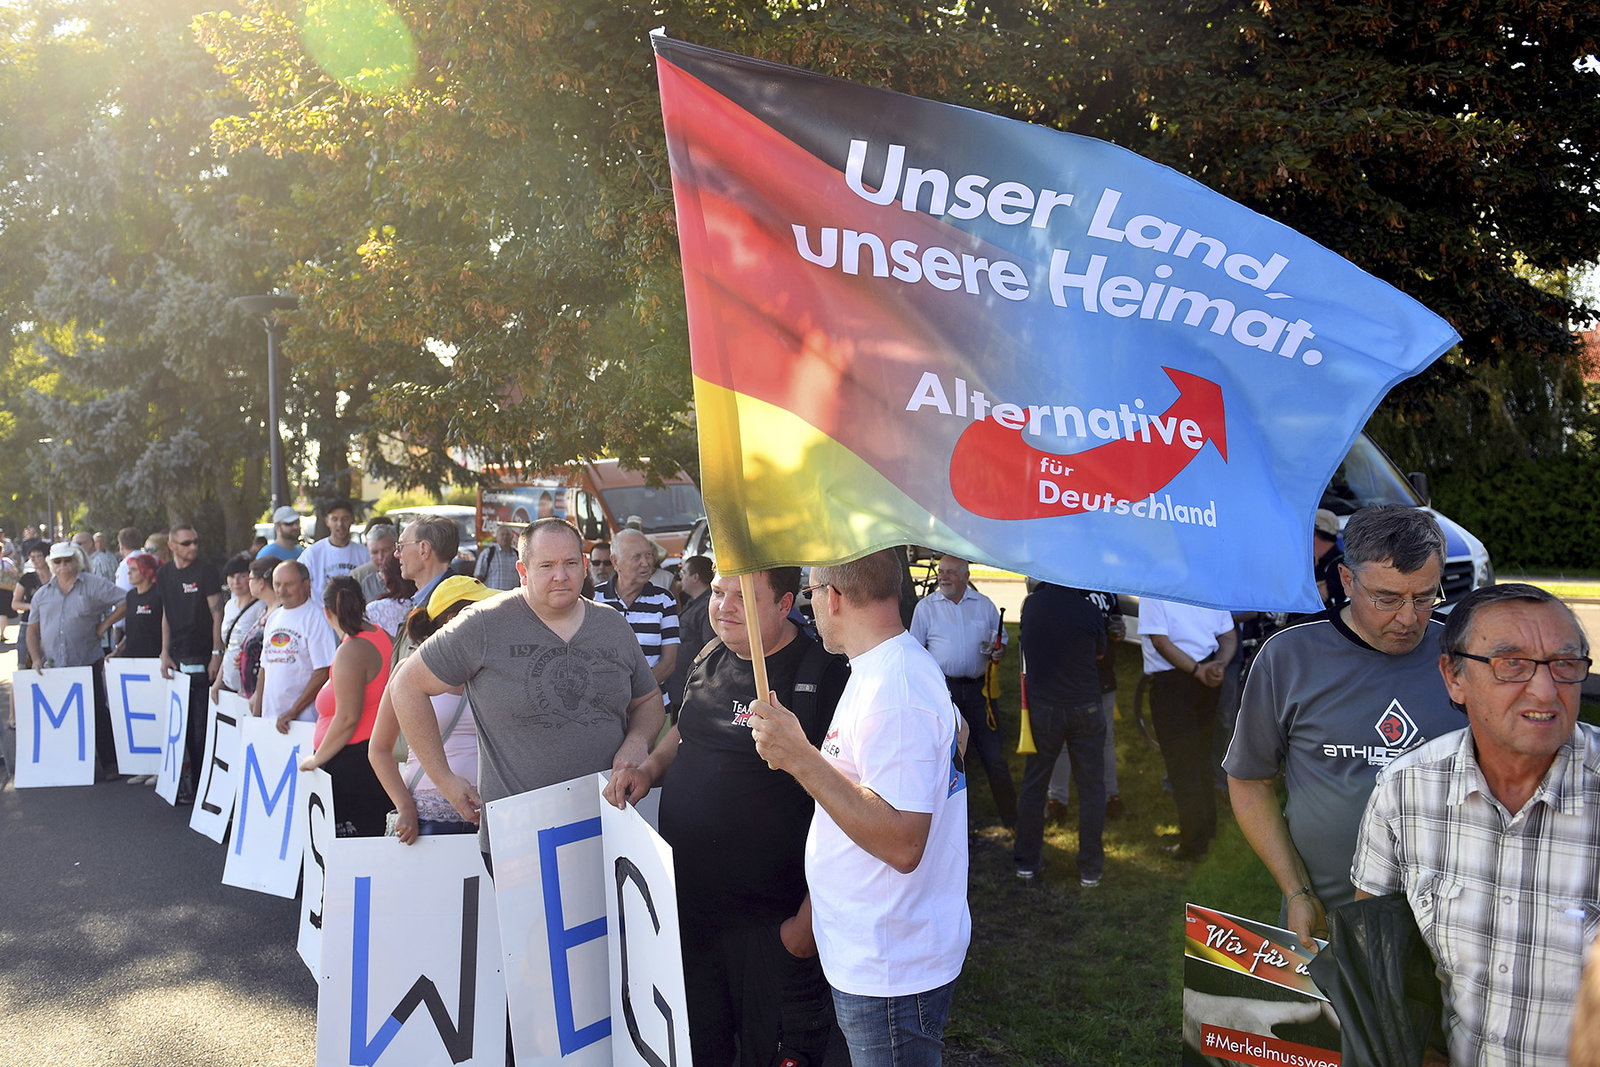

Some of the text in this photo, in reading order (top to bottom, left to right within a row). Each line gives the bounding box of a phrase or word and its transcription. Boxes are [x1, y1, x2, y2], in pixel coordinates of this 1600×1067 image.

[845, 139, 1294, 300] Unser Land,
[791, 224, 1324, 367] unsere Heimat.
[905, 371, 1205, 450] Alternative
[1040, 457, 1075, 478] für
[1038, 480, 1218, 528] Deutschland
[1206, 924, 1248, 955] Wir
[1250, 939, 1289, 974] für
